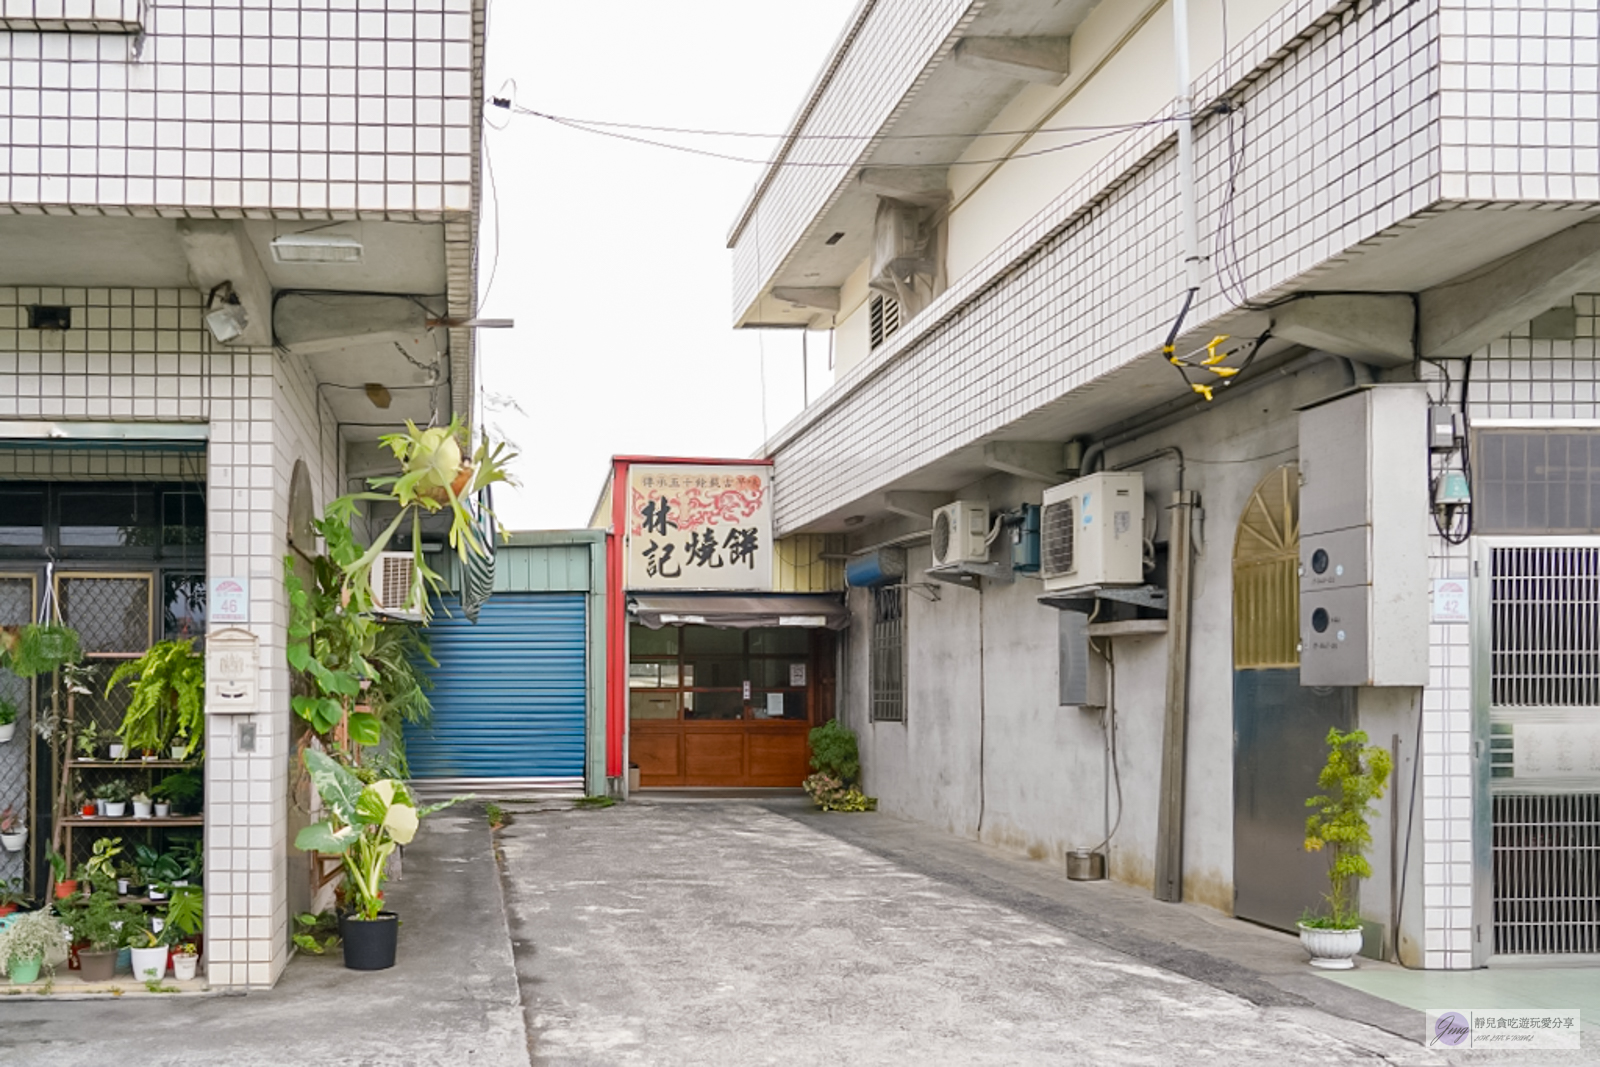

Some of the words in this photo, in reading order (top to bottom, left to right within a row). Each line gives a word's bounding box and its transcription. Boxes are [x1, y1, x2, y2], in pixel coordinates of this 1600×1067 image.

[641, 495, 681, 578] 林記
[684, 527, 759, 570] 燒餅
[221, 599, 238, 613] 46
[1443, 600, 1459, 613] 42
